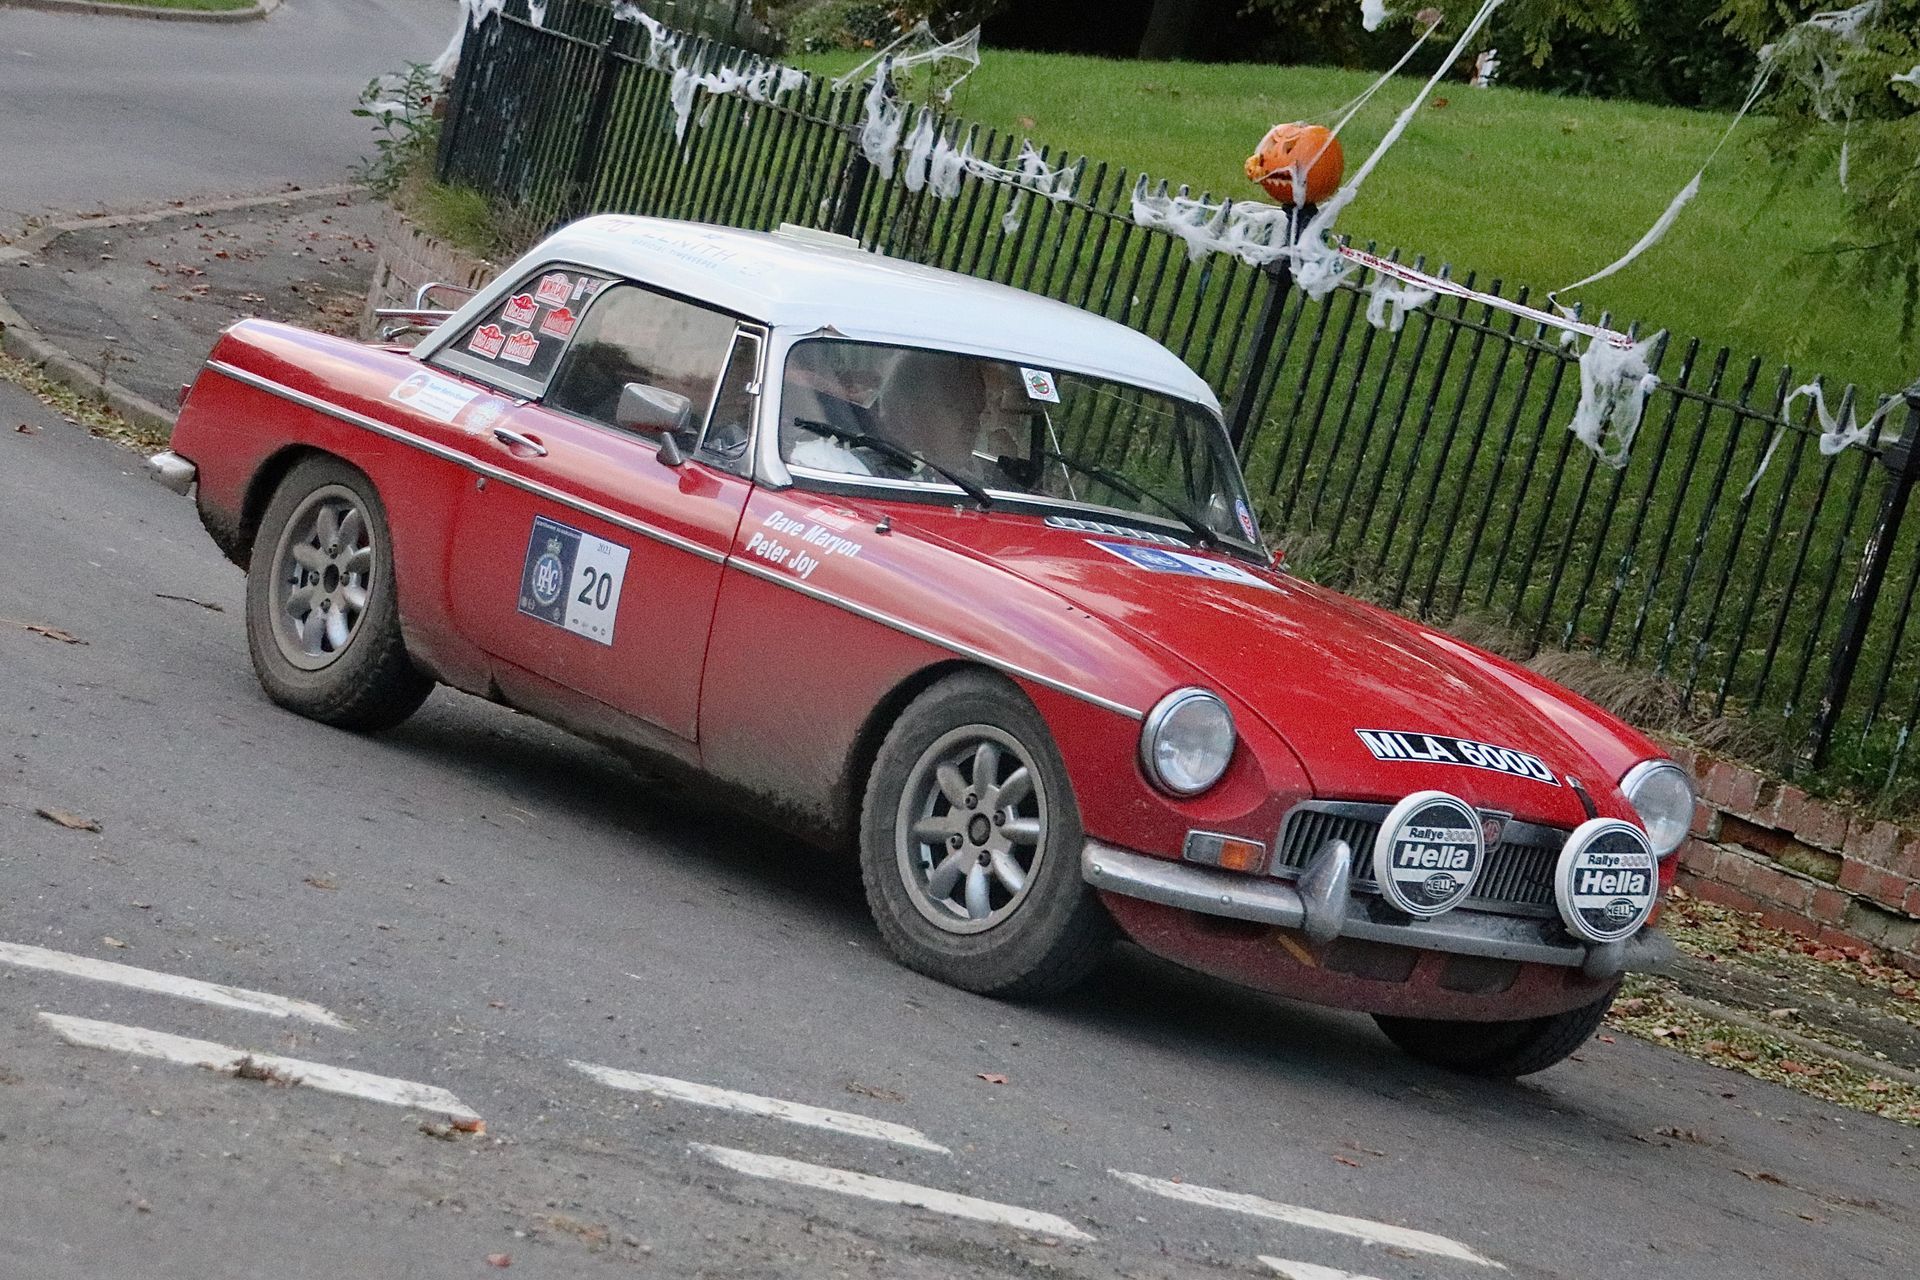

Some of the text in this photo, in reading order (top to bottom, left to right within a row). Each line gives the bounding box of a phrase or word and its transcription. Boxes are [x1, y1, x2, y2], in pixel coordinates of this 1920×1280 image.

[763, 511, 805, 536] Dave
[802, 524, 862, 557] Maryon
[745, 532, 819, 579] Peter Joy
[537, 560, 559, 595] RAC
[578, 566, 612, 610] 20
[1360, 732, 1554, 781] MLA 600D
[1409, 827, 1444, 841] Rallye
[1400, 843, 1469, 868] Hella
[1588, 854, 1620, 867] Rallye
[1580, 870, 1646, 894] Hella
